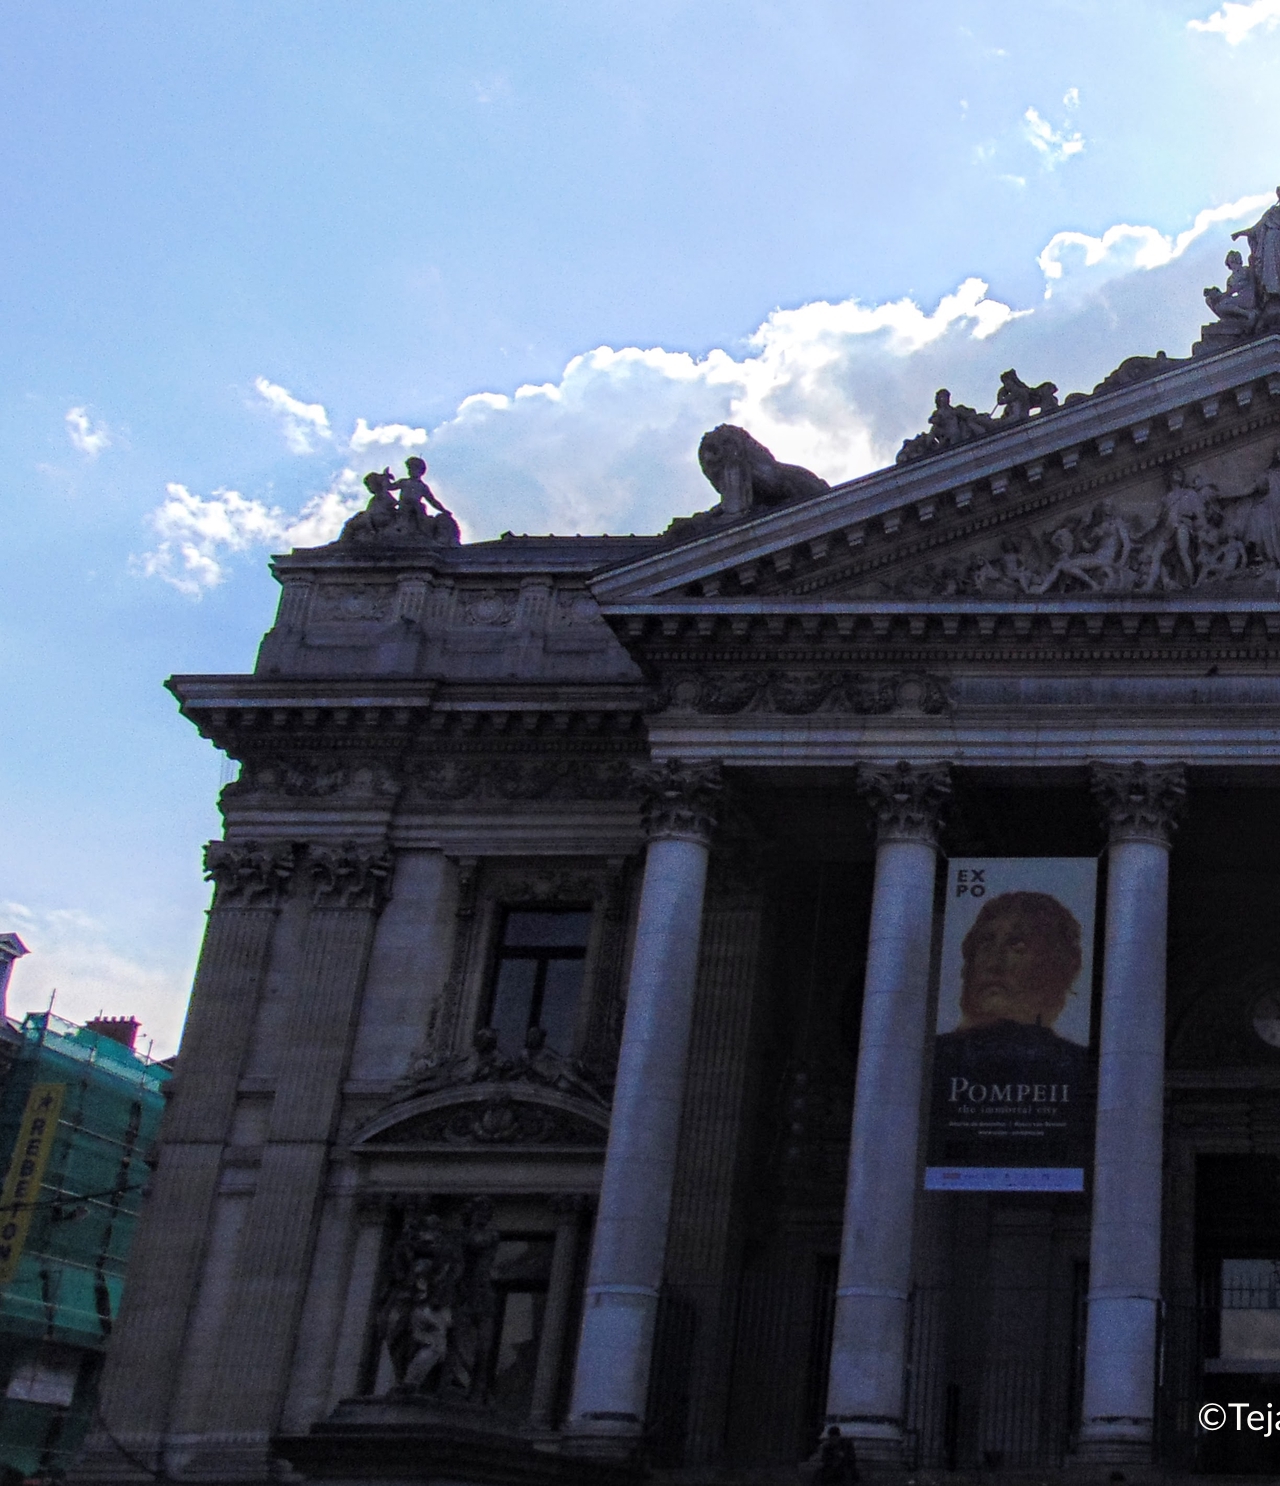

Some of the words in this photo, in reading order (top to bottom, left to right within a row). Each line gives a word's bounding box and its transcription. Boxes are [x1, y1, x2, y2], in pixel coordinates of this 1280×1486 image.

[957, 869, 985, 882] EX
[956, 884, 985, 897] PO
[948, 1077, 1070, 1103] POMPEII
[958, 1105, 976, 1114] the
[981, 1105, 1032, 1114] immortal
[1036, 1106, 1059, 1116] city
